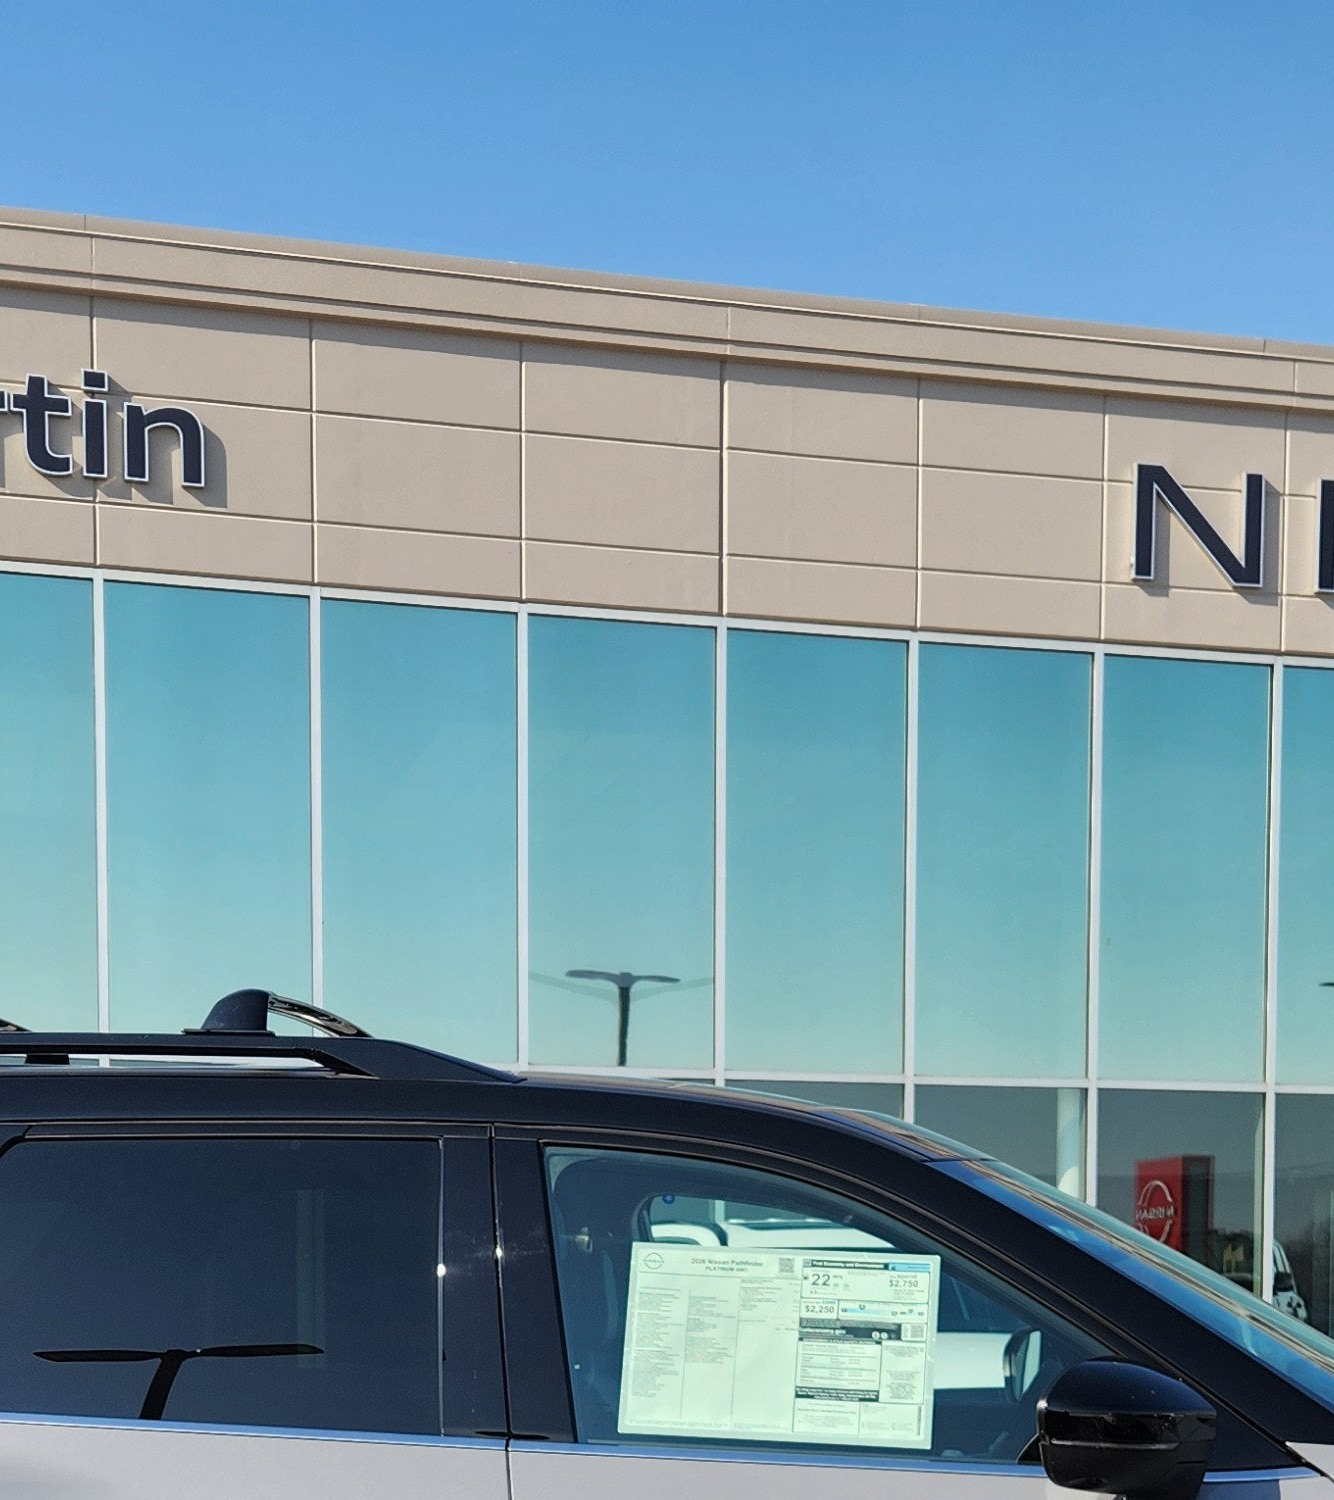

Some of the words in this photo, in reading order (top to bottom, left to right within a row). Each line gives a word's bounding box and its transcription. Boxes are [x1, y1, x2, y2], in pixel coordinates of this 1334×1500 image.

[811, 1273, 830, 1287] 22
[889, 1279, 919, 1288] $2,750
[805, 1305, 835, 1314] $2,250
